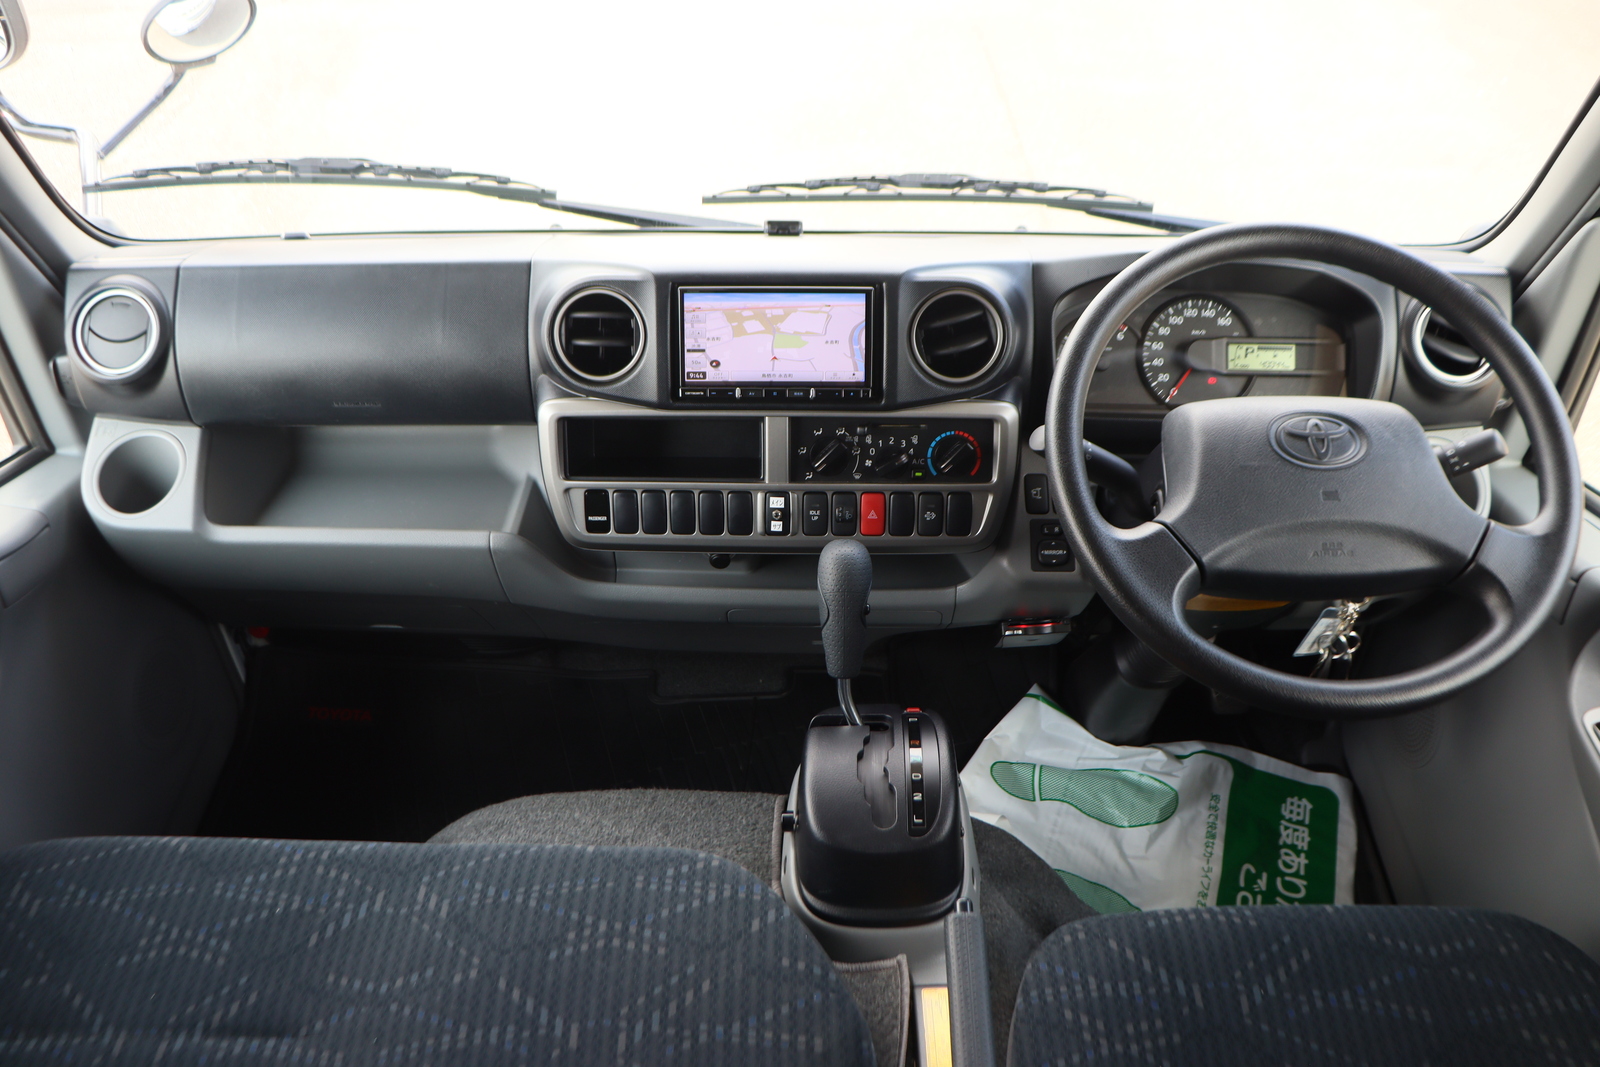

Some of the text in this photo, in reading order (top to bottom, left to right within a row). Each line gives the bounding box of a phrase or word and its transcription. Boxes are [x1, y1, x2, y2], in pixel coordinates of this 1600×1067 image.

[1183, 308, 1198, 318] 120
[1201, 308, 1216, 318] 140
[1168, 315, 1184, 325] 100
[1217, 317, 1232, 327] 160
[1158, 326, 1171, 336] 80
[1151, 341, 1164, 351] 60
[1244, 346, 1255, 358] P
[1151, 357, 1164, 367] 40
[1157, 373, 1170, 383] 20
[889, 436, 895, 445] 2
[900, 439, 906, 448] 3
[869, 447, 876, 456] 0
[908, 447, 914, 455] 4
[308, 706, 373, 722] TOYOTA
[911, 772, 922, 780] D
[913, 792, 922, 800] 2
[913, 814, 923, 823] L
